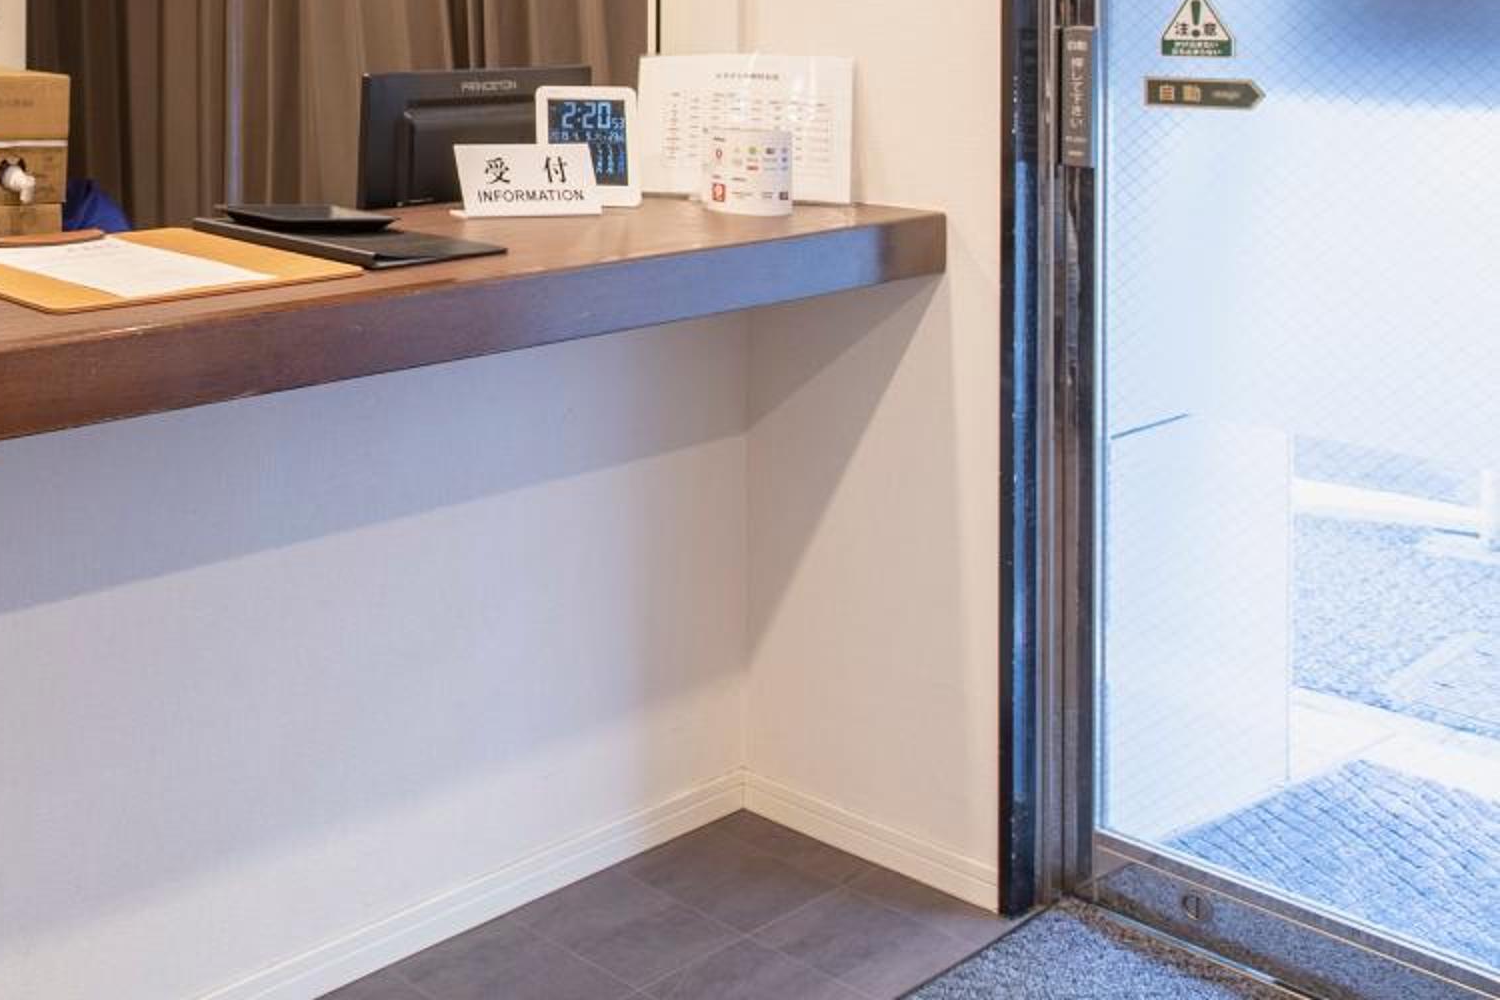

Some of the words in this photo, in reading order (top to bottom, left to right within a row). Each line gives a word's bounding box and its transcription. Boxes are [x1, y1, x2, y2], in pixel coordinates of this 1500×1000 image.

[1175, 22, 1217, 37] 注意
[1159, 84, 1202, 102] 自動
[561, 101, 612, 129] 2:20
[484, 156, 568, 184] 受付
[477, 189, 585, 204] INFORMATION
